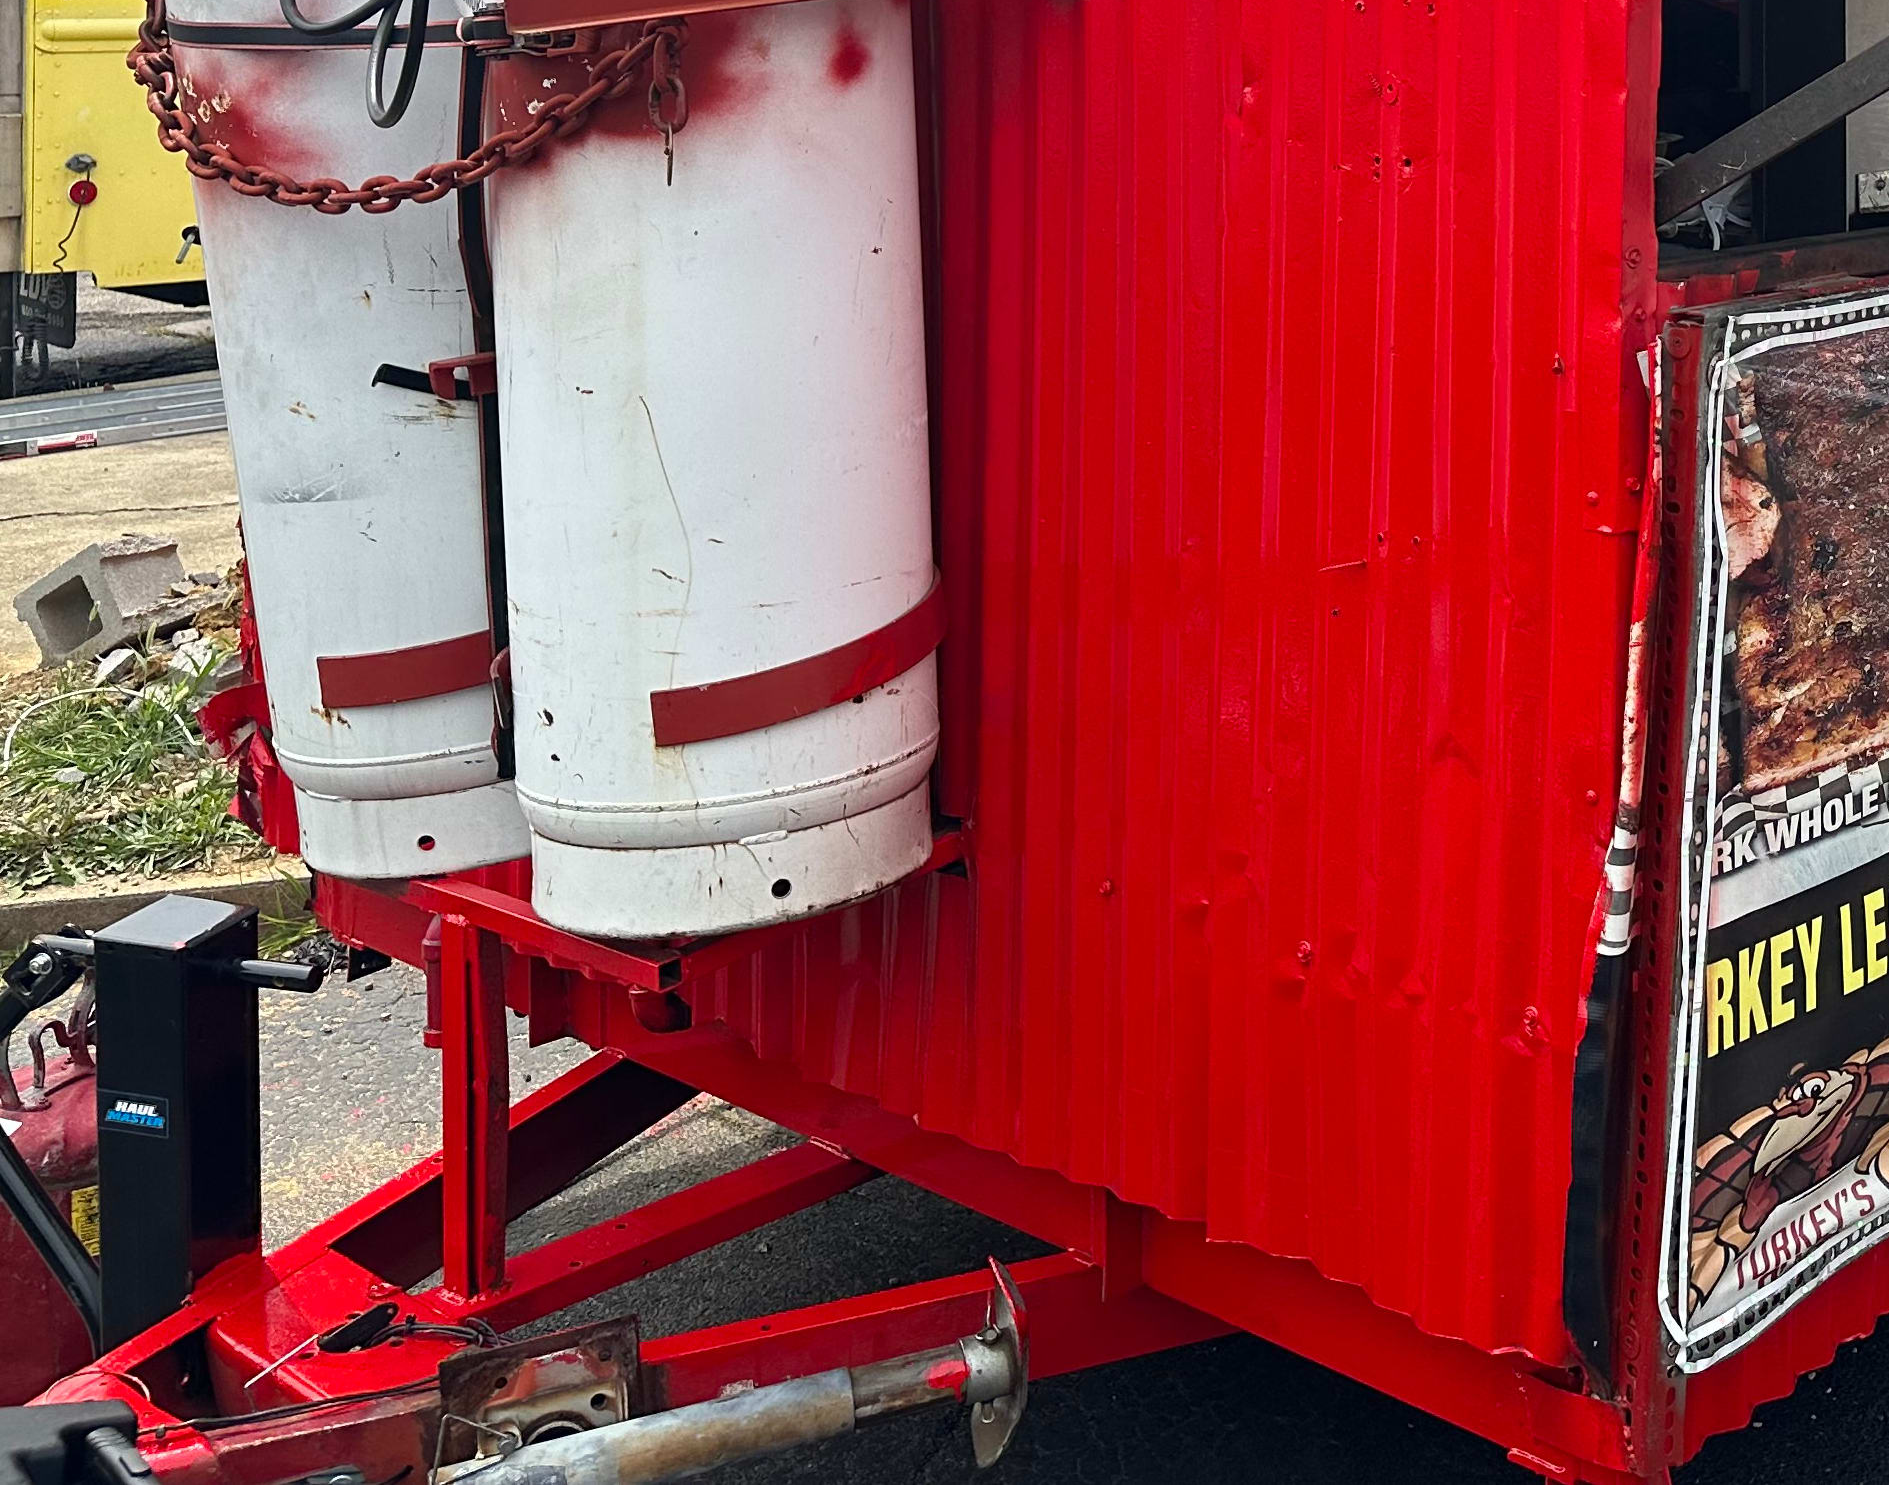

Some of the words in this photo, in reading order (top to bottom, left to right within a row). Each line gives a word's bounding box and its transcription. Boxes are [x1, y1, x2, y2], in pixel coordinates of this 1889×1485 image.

[1763, 790, 1880, 855] WHOLE
[1706, 915, 1823, 1058] RKEY
[106, 1109, 164, 1129] MASTER
[115, 1100, 158, 1117] HAUL
[1734, 1178, 1875, 1291] TURKEY'S
